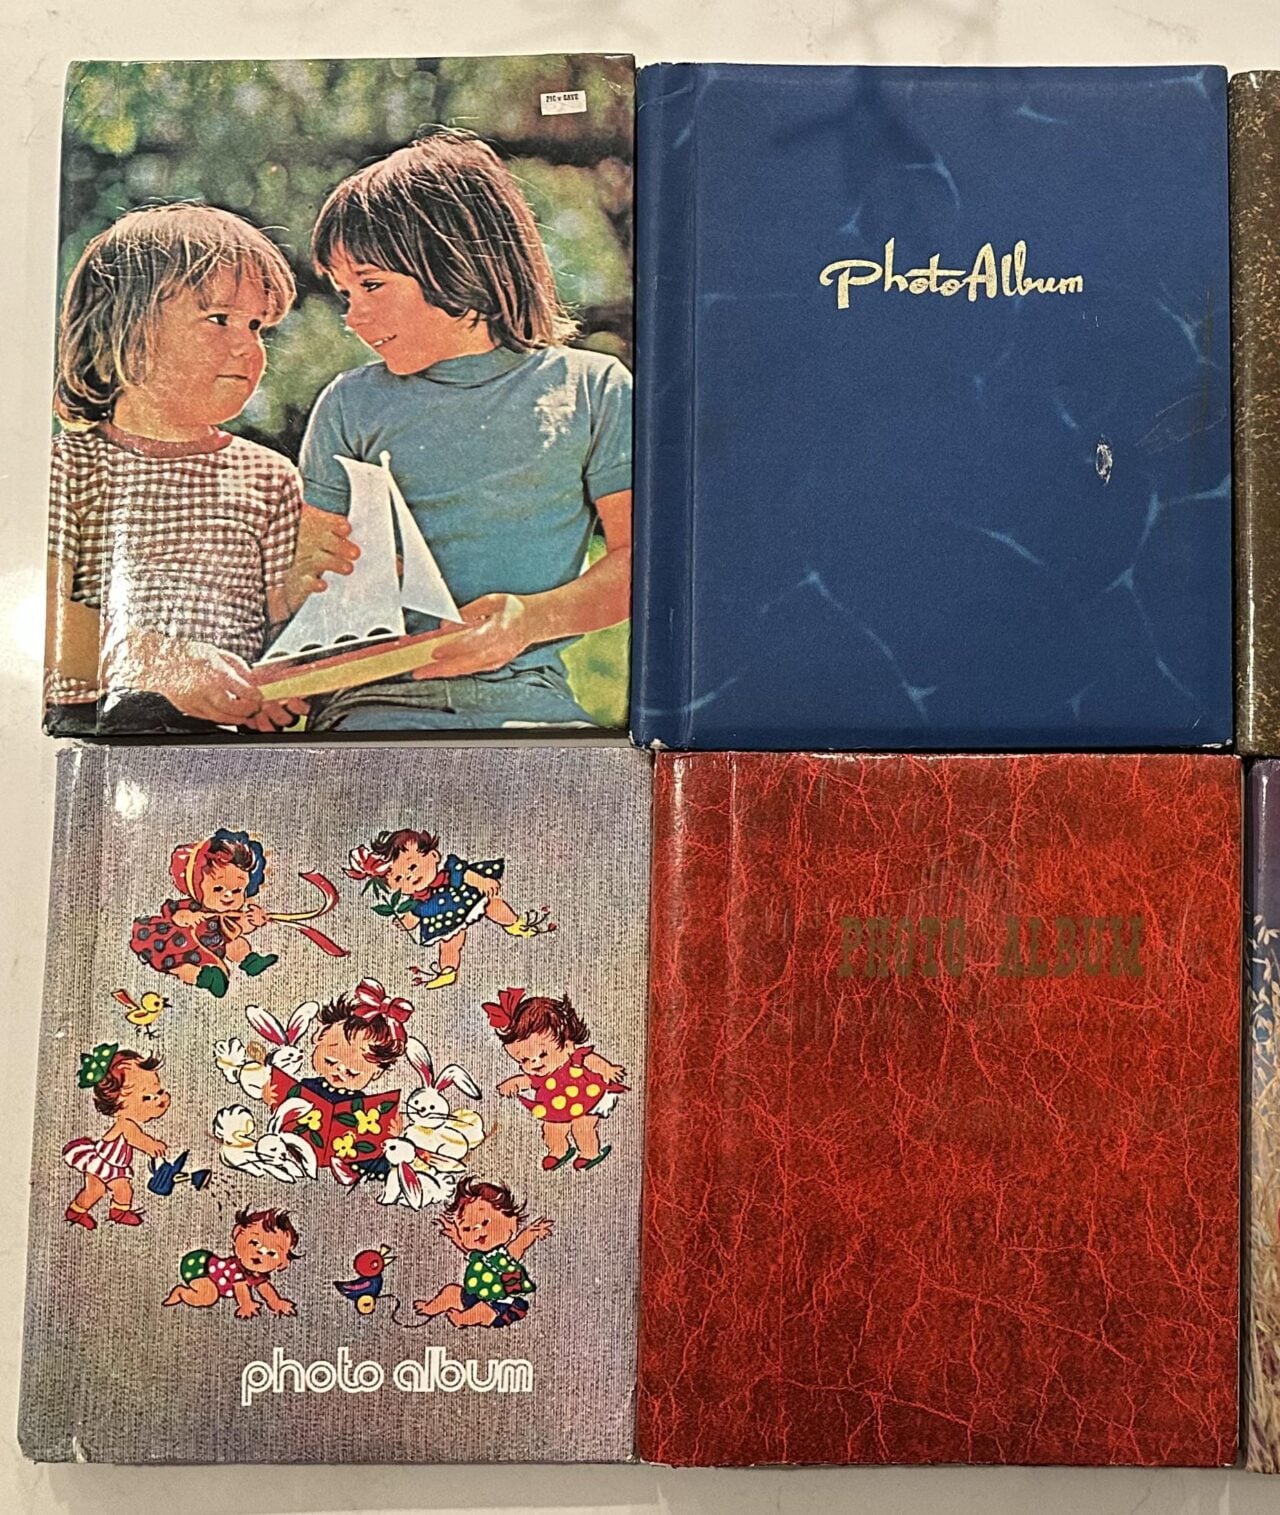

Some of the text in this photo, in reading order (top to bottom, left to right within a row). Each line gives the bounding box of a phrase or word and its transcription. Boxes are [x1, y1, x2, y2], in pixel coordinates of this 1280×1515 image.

[837, 915, 1144, 977] PHOTO ALBUM
[241, 1346, 533, 1406] photo album
